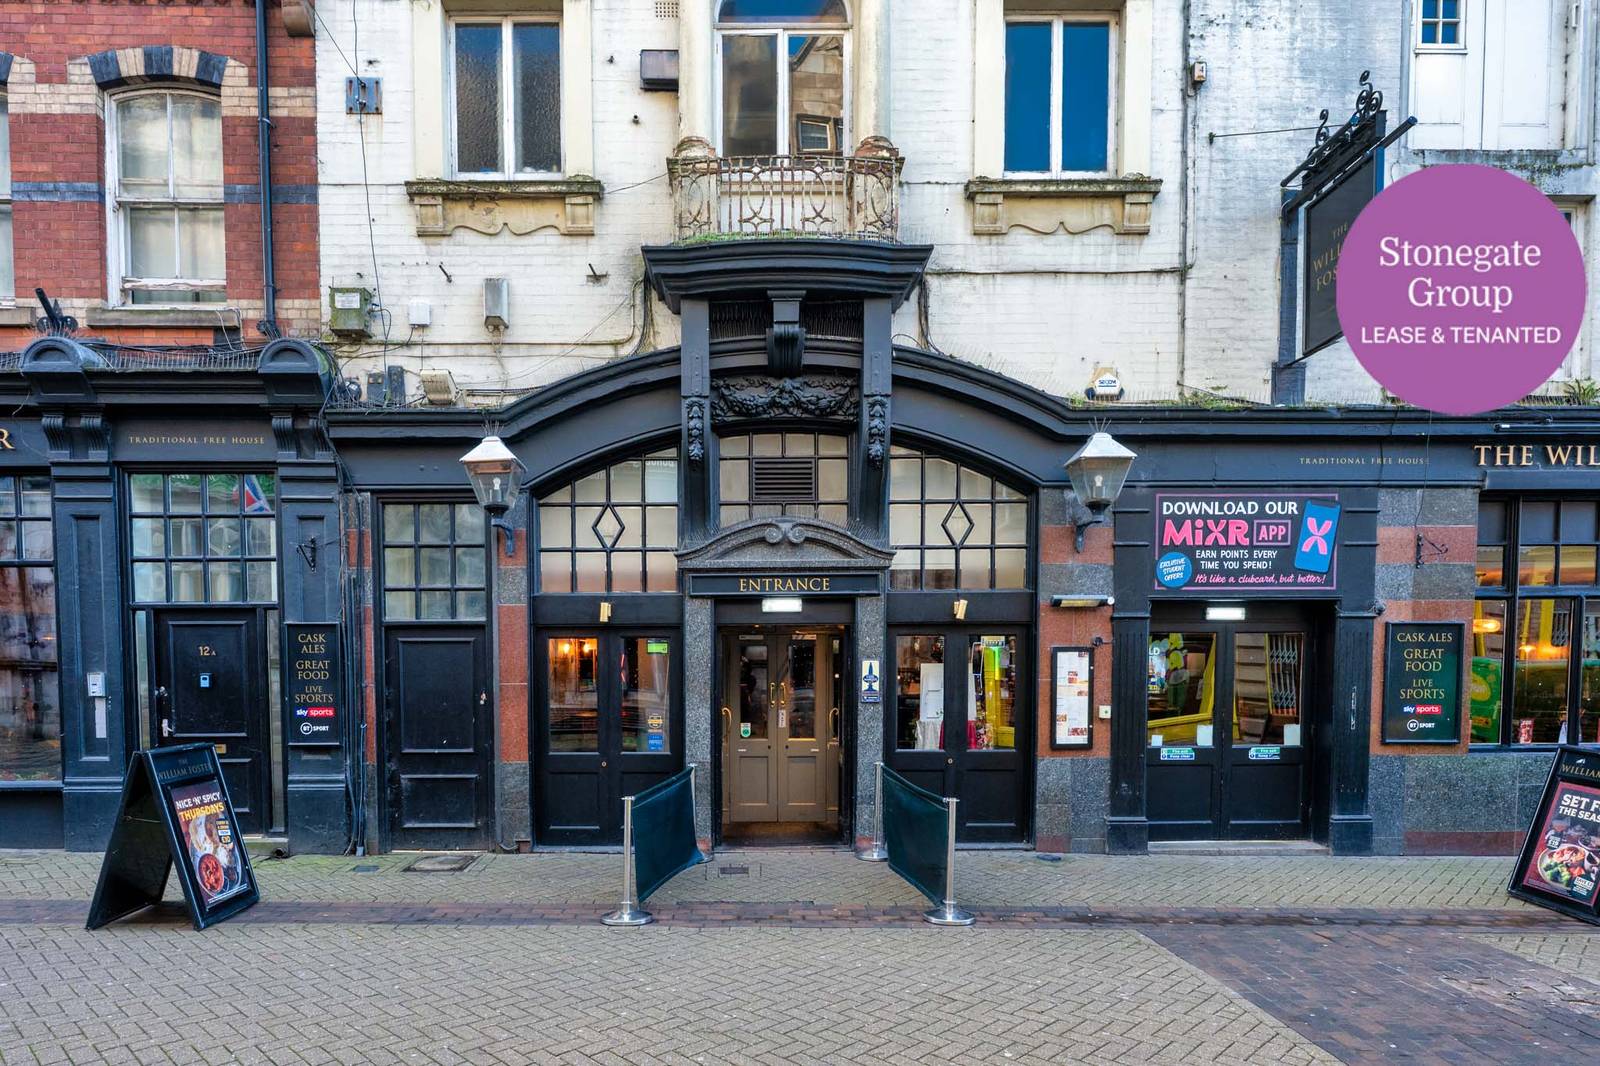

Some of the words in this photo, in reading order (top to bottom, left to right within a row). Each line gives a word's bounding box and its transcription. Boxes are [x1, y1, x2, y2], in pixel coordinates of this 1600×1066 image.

[0, 429, 14, 450] R
[129, 436, 199, 444] TRADITIONAL
[1474, 445, 1534, 466] THE
[1545, 445, 1600, 466] WIL
[1299, 457, 1366, 465] TRADITIONAL
[1371, 457, 1393, 465] FREE
[1162, 501, 1259, 515] DOWNLOAD
[1265, 501, 1298, 515] OUR
[1258, 525, 1287, 541] APP
[1195, 550, 1217, 559] EARN
[1220, 550, 1249, 559] POINTS
[1253, 550, 1278, 559] EVERY
[1200, 561, 1220, 569] TIME
[1223, 561, 1240, 569] YOU
[1194, 574, 1207, 583] It's
[1209, 574, 1226, 583] like
[1238, 573, 1278, 584] clubcard,
[1279, 574, 1294, 583] but
[1297, 573, 1327, 584] better!
[739, 577, 830, 592] ENTRANCE
[298, 633, 326, 643] CASK
[1397, 632, 1426, 643] CASK
[1428, 632, 1453, 643] ALES
[301, 644, 325, 654] ALES
[1403, 648, 1444, 660] GREAT
[296, 660, 330, 670] GREAT
[1405, 661, 1442, 672] FOOD
[298, 671, 329, 680] FOOD
[1412, 679, 1433, 687] LIVE
[305, 685, 323, 693] LIVE
[1400, 689, 1445, 699] SPORTS
[295, 694, 334, 703] SPORTS
[296, 708, 308, 717] sky
[309, 708, 334, 717] sports
[1403, 705, 1415, 714] sky
[1416, 705, 1439, 714] sports
[175, 798, 193, 810] NICE
[202, 791, 220, 803] SPICY
[1561, 793, 1590, 810] SET
[179, 802, 225, 822] THURSDAYS
[1558, 805, 1578, 817] THE
